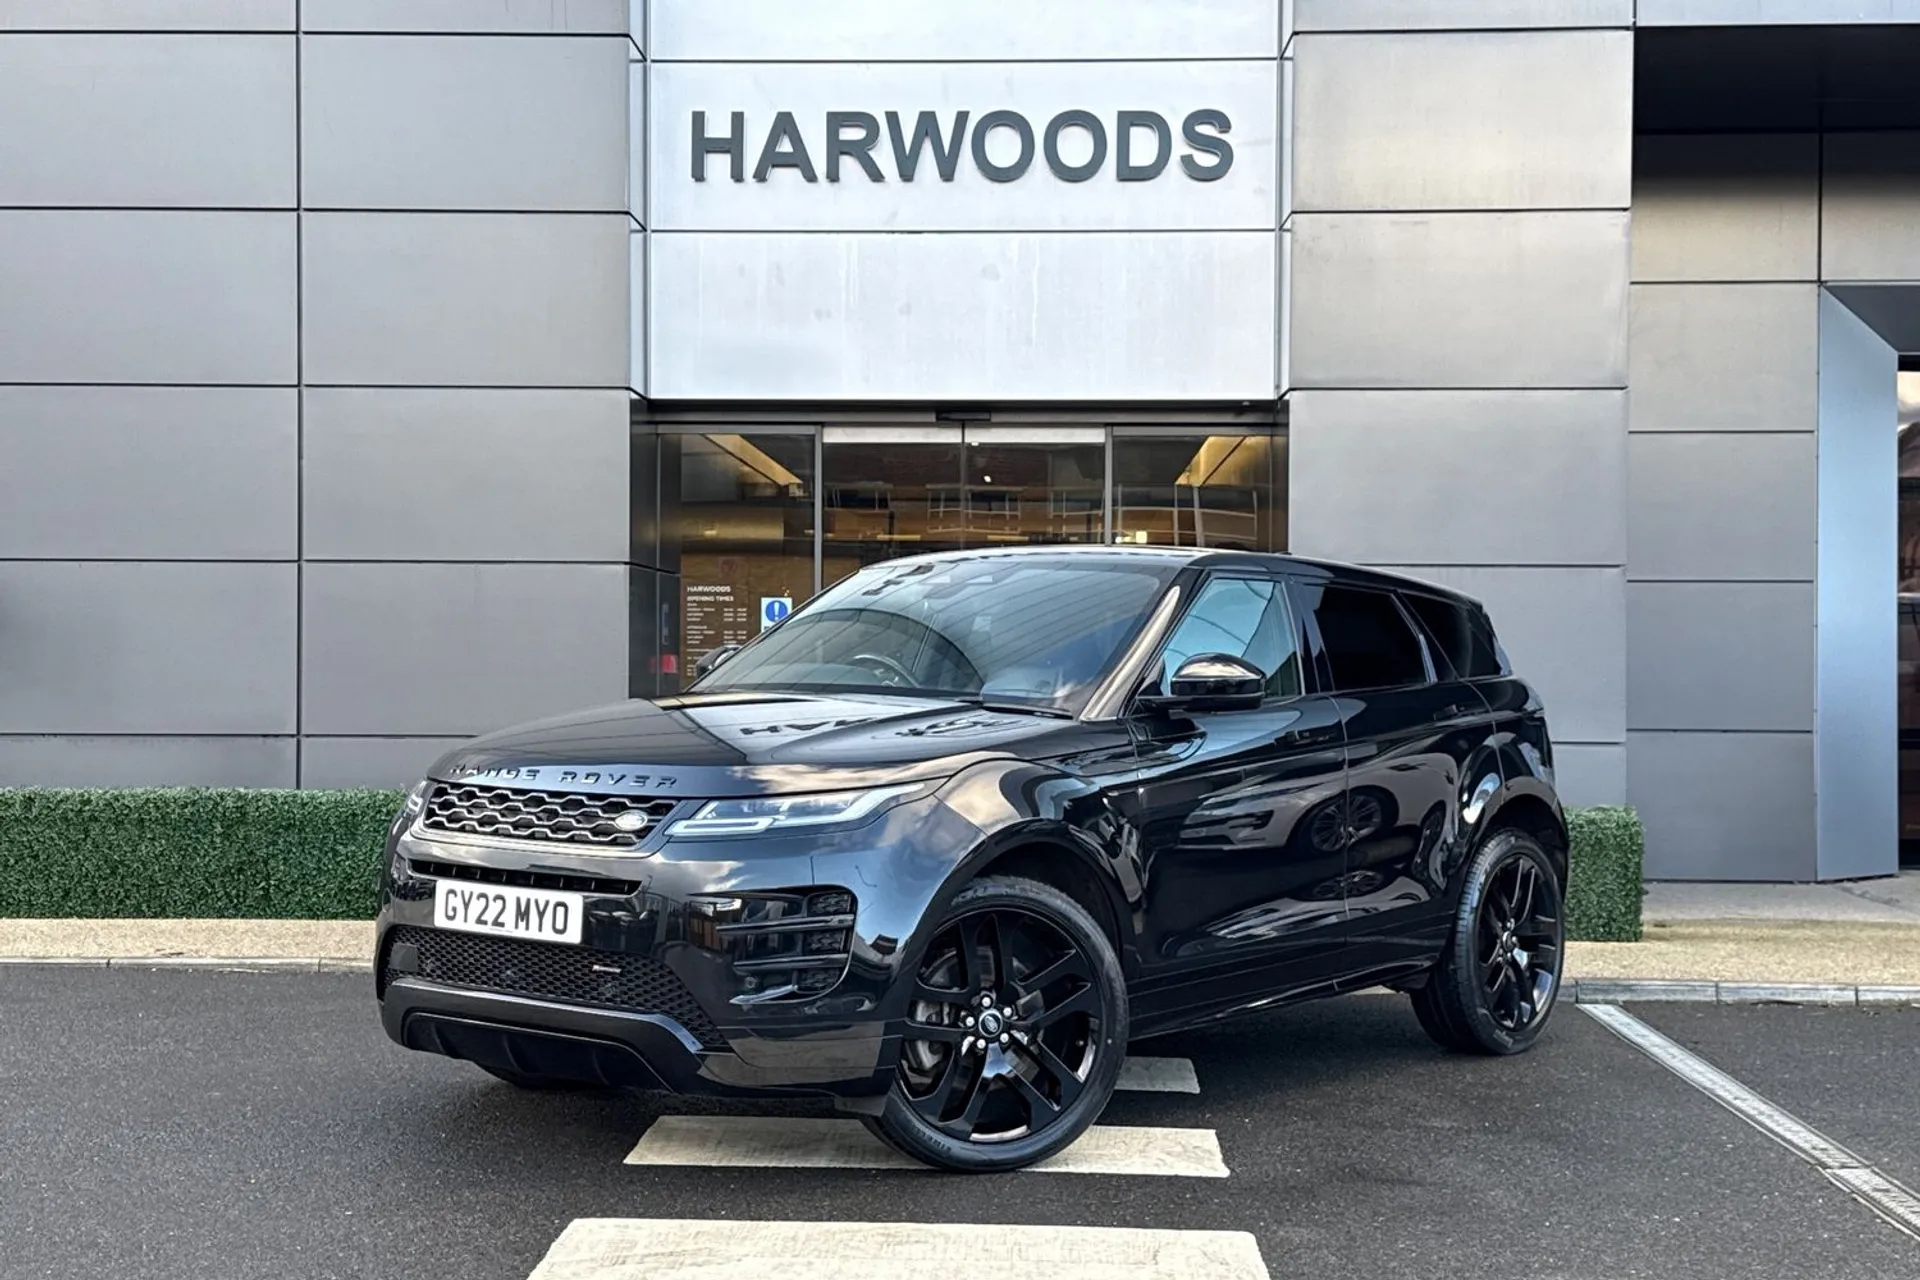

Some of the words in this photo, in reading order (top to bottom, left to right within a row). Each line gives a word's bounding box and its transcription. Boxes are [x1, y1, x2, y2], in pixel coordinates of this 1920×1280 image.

[691, 109, 1235, 182] HARWOODS
[557, 770, 678, 788] ROVER
[444, 888, 507, 928] GY22
[514, 895, 569, 936] MYO
